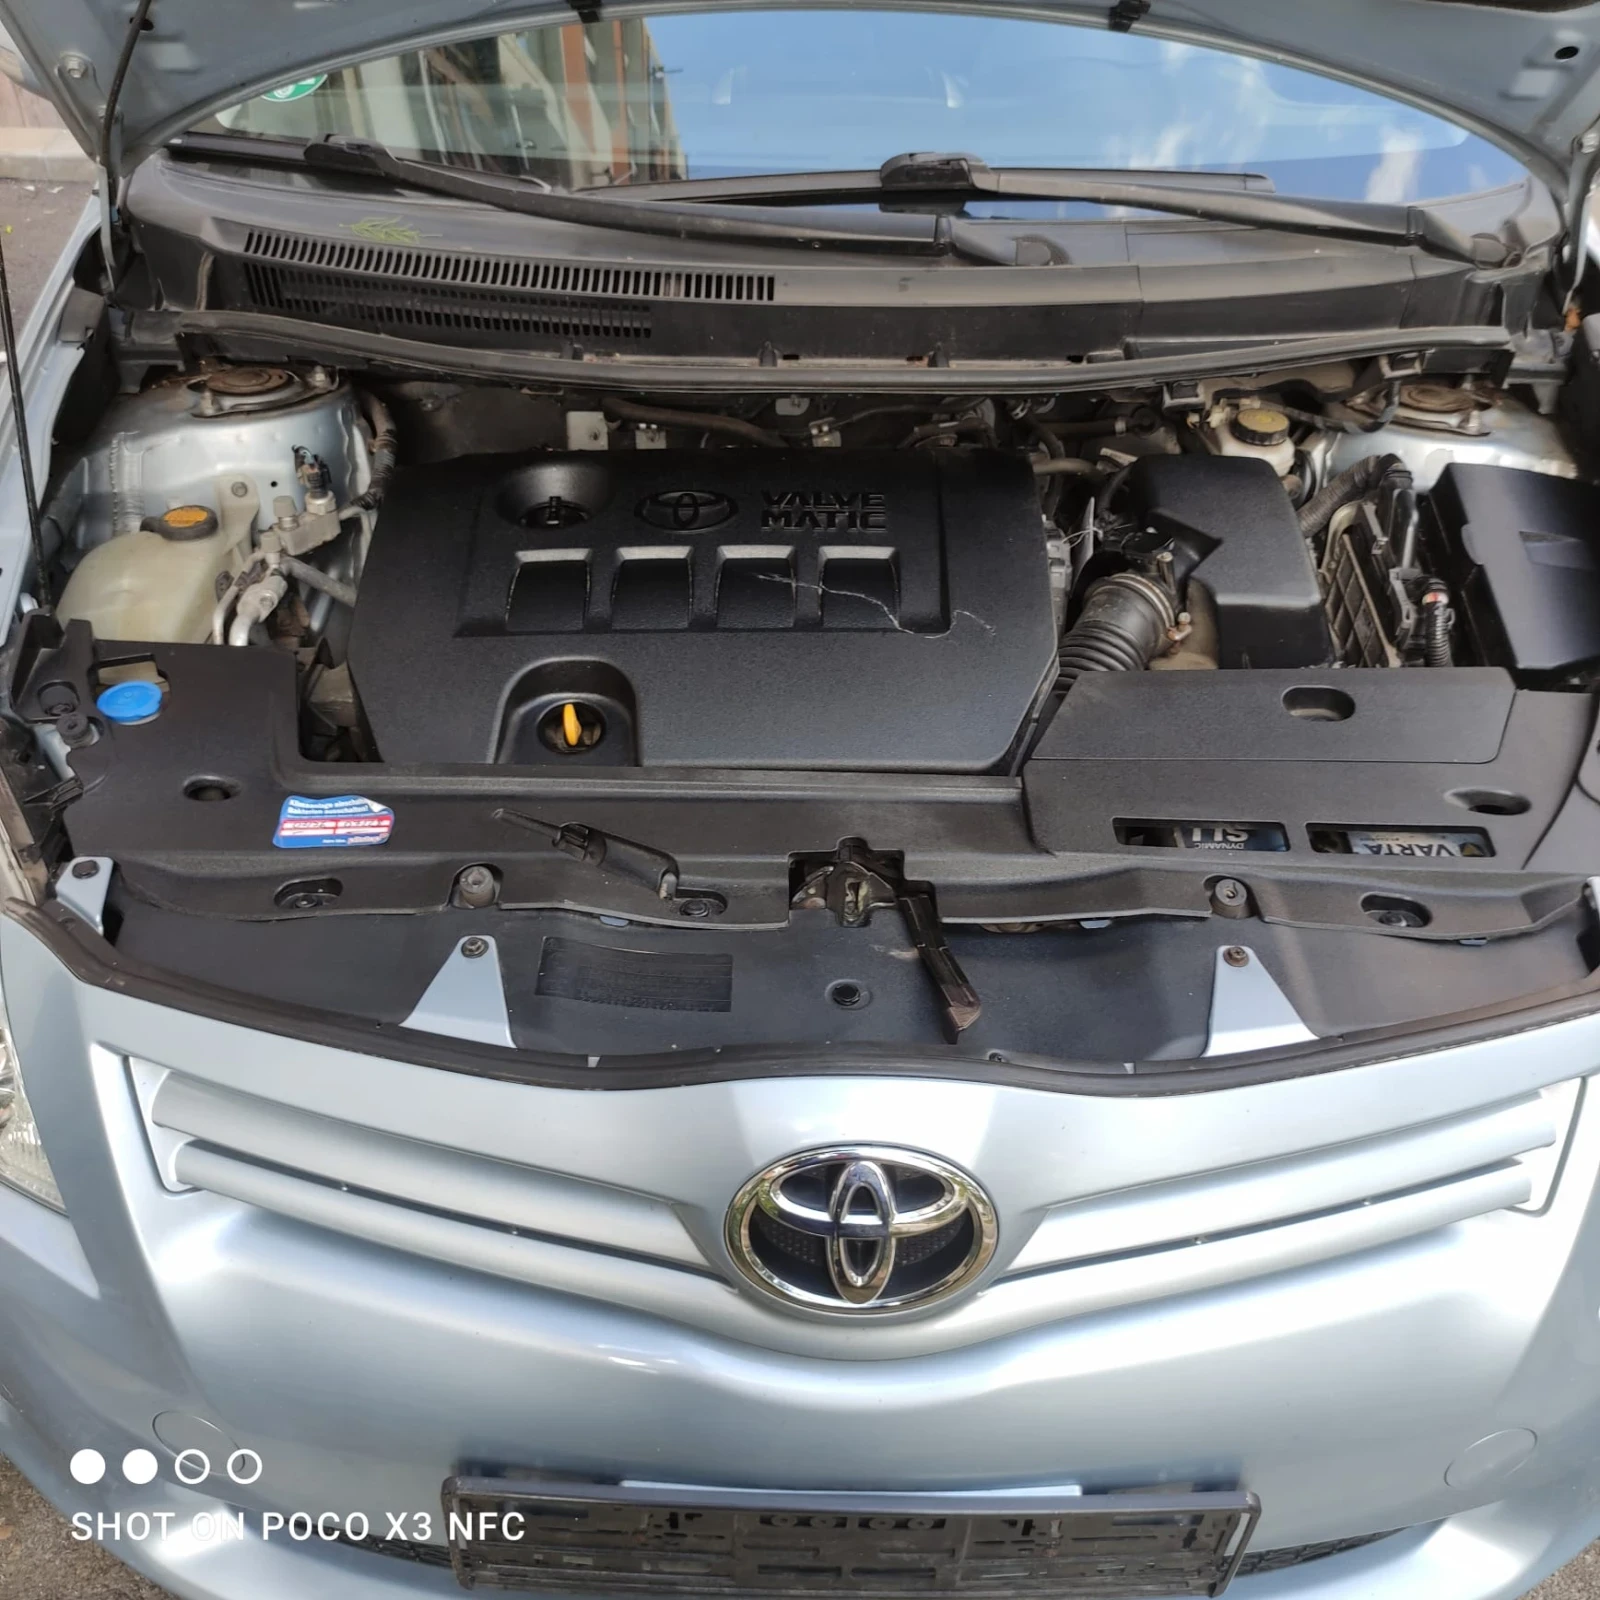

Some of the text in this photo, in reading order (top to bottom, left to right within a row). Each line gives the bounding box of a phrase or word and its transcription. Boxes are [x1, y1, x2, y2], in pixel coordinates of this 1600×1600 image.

[760, 490, 886, 509] VALVE
[760, 509, 887, 532] MATIC
[1194, 842, 1245, 850] DYNAMIC
[1362, 843, 1456, 857] VARTA
